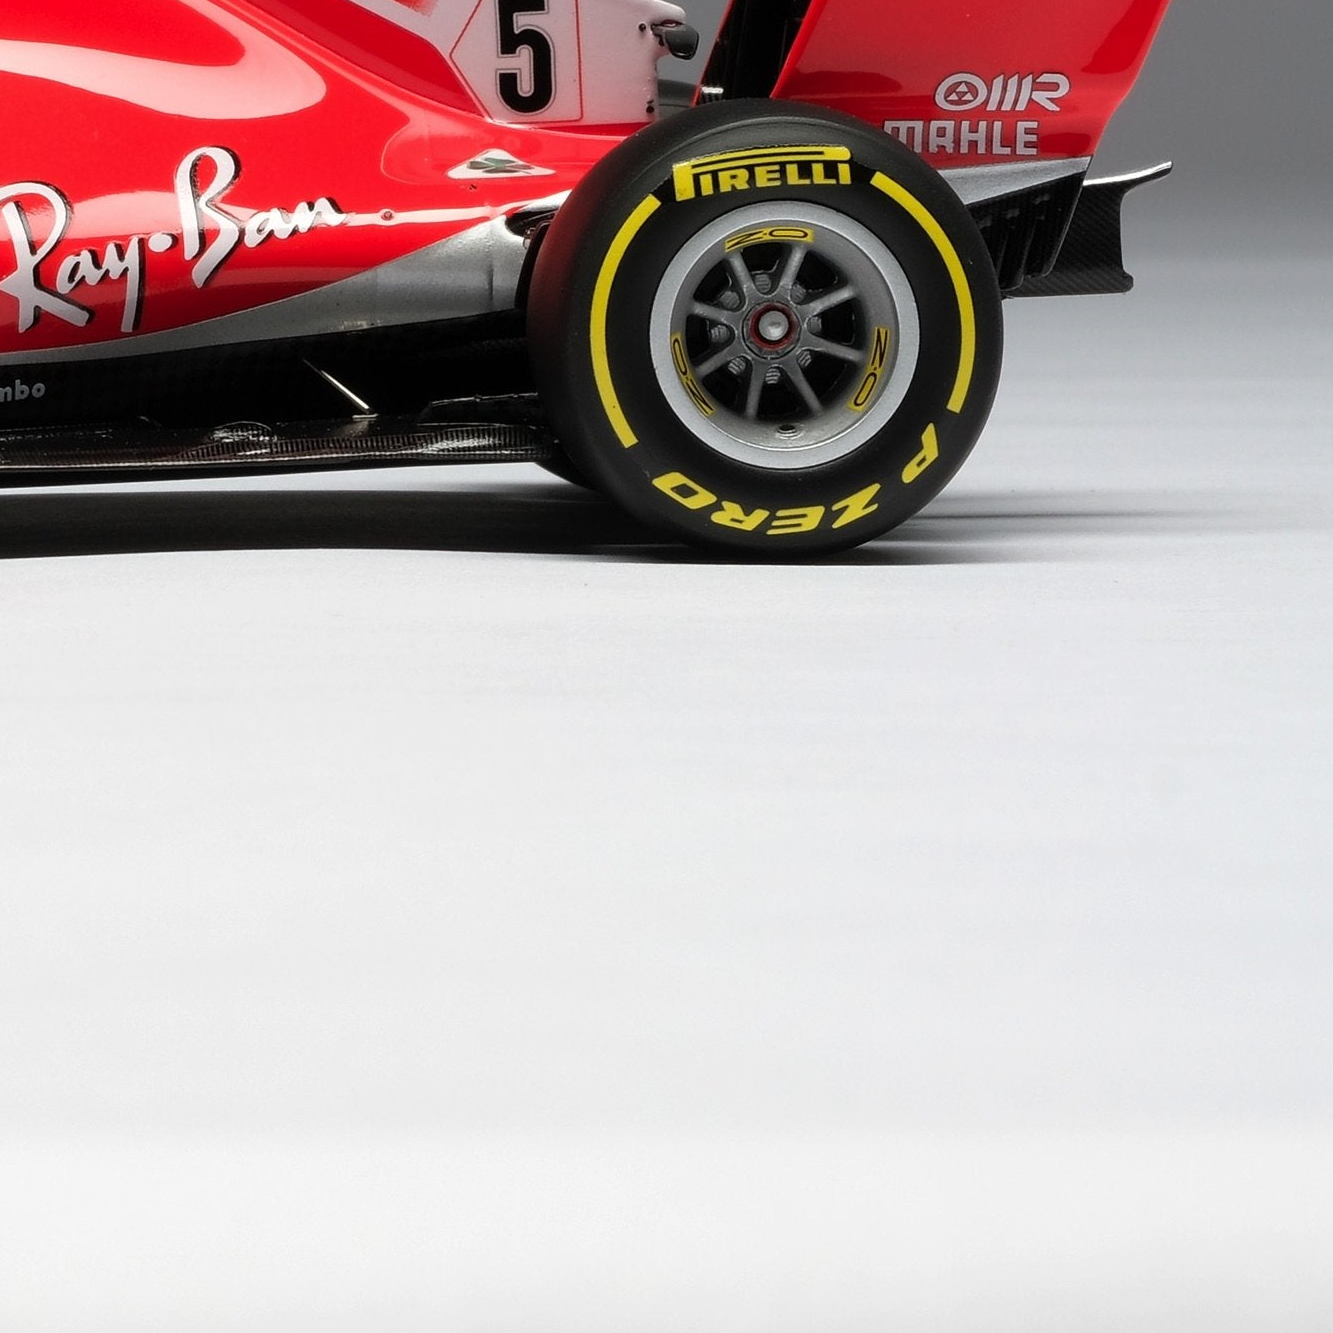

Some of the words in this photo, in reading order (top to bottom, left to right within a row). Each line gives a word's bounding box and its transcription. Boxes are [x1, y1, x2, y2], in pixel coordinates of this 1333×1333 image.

[884, 120, 1039, 156] MAHLE
[672, 145, 851, 201] PIRELLI
[901, 422, 940, 484] P
[652, 471, 881, 536] ZERO
